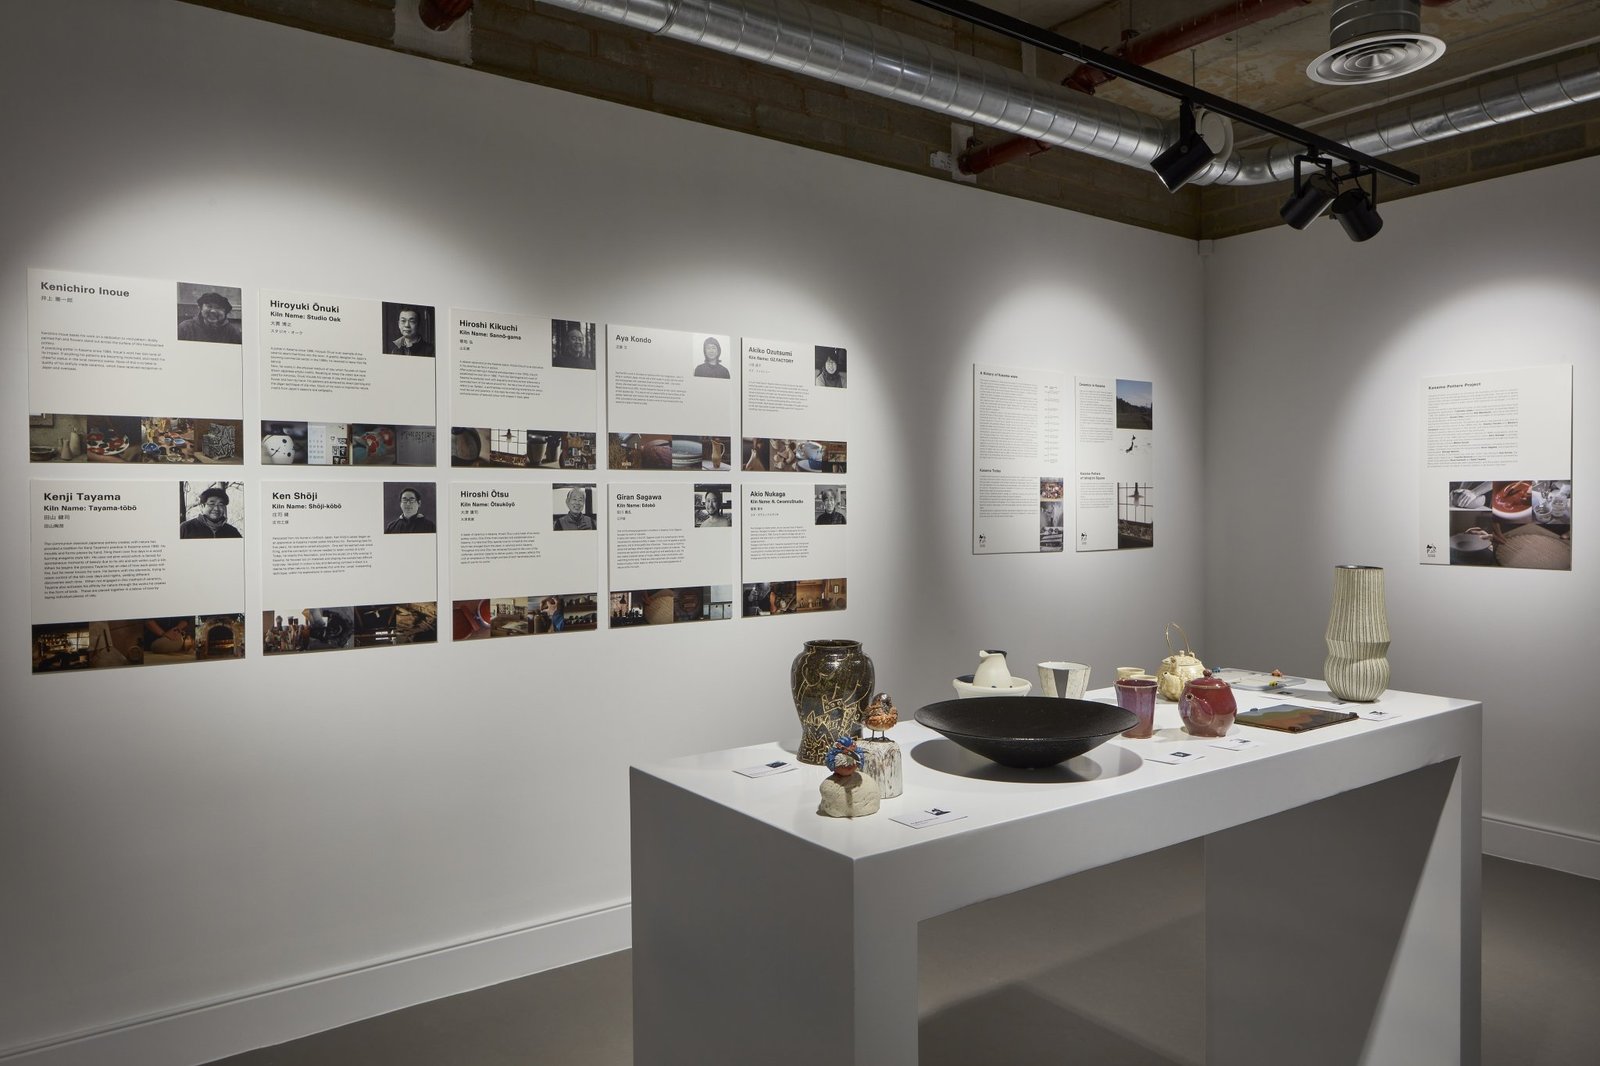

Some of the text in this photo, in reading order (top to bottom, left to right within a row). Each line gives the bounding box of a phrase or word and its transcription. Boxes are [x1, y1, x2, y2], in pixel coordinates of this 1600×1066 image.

[40, 281, 130, 297] Kenichiro Inoue
[270, 300, 309, 311] Hiroyuki
[285, 312, 306, 320] Name:
[459, 319, 518, 332] Hiroshi Kikuchi
[615, 334, 652, 344] Aya Kondo
[748, 346, 793, 357] Akiko Ozutsumi
[43, 492, 121, 503] Kenji Tayama
[272, 492, 291, 500] Ken
[460, 490, 489, 498] Hiroshi
[636, 493, 662, 501] Sagawa
